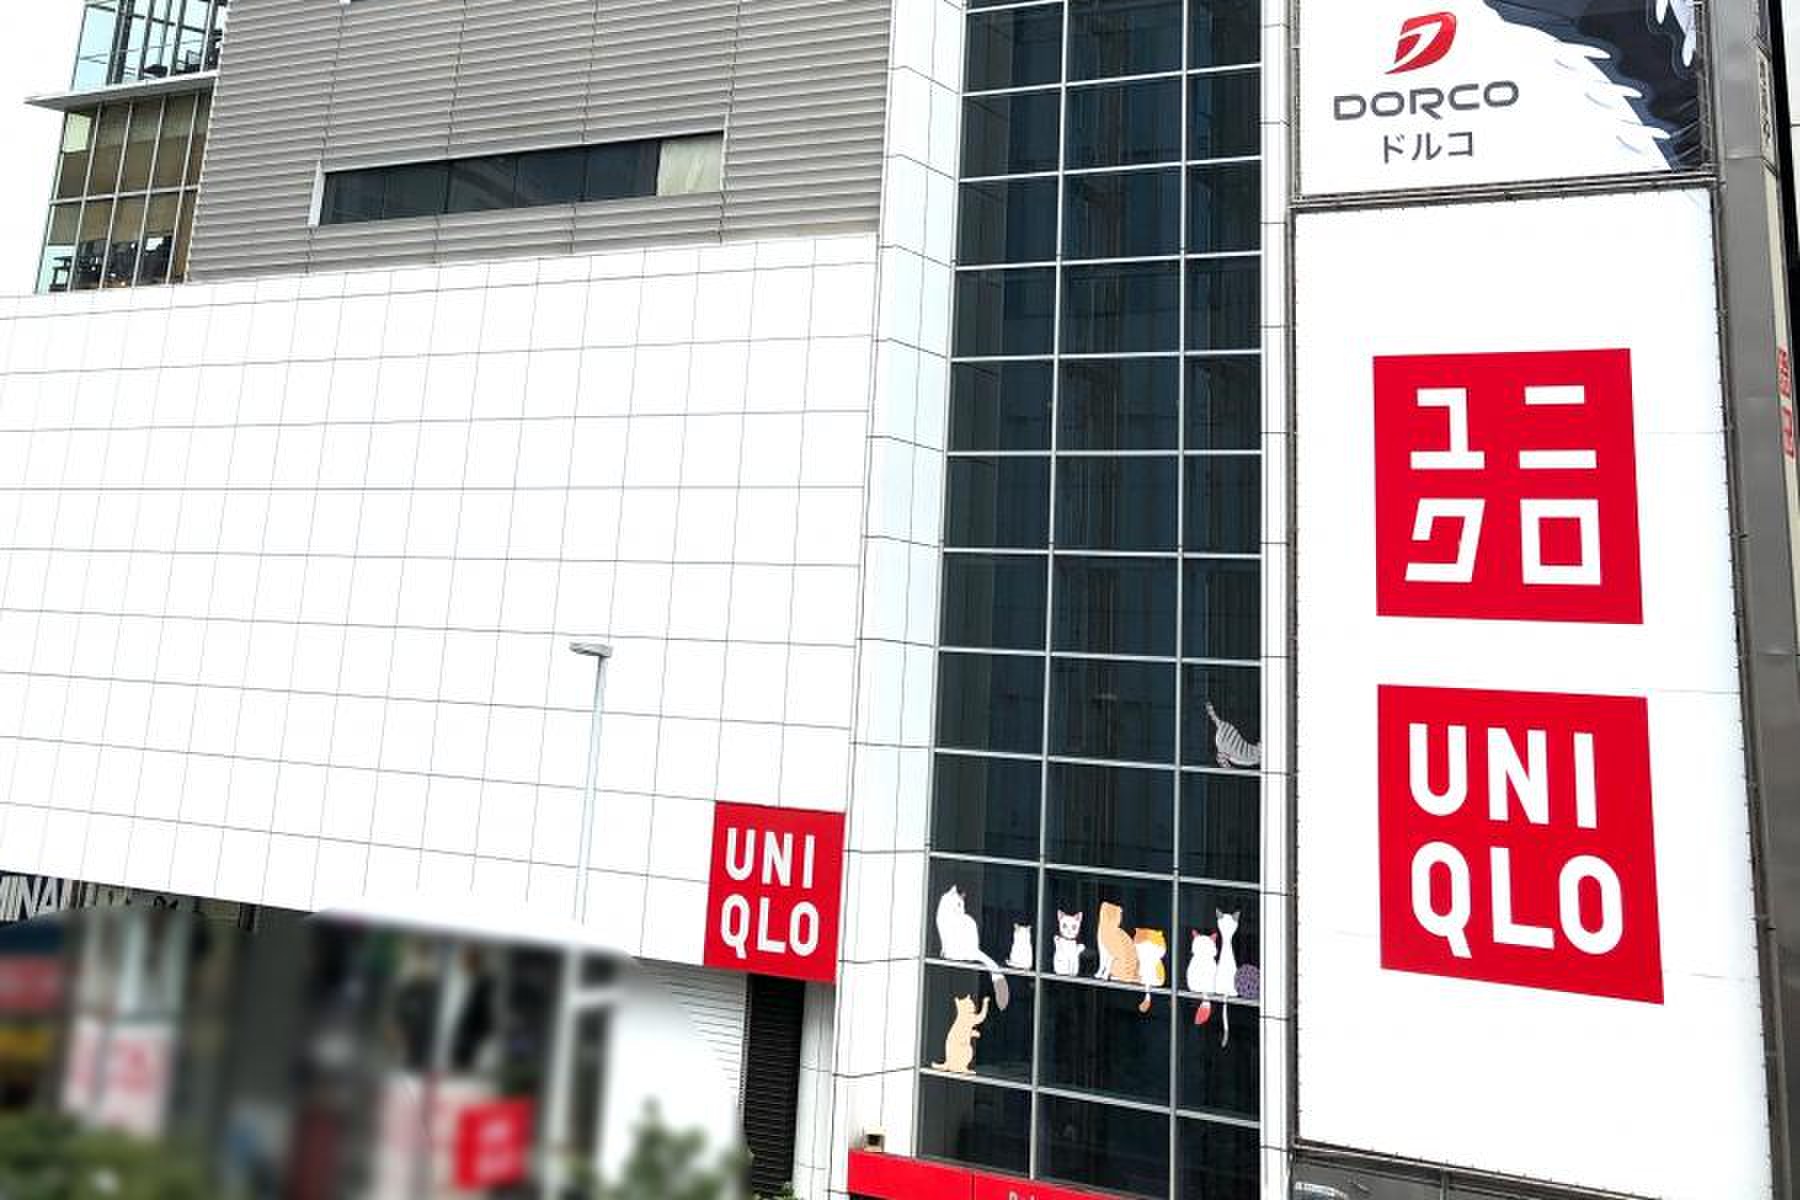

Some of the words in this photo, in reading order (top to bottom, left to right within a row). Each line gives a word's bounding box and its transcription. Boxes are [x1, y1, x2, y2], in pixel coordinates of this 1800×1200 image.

[1333, 80, 1520, 120] DORCO
[1383, 131, 1473, 163] ドルコ
[1409, 722, 1597, 829] UNI
[725, 827, 815, 889] UNI
[720, 893, 819, 959] QLO
[1410, 841, 1623, 959] QLO
